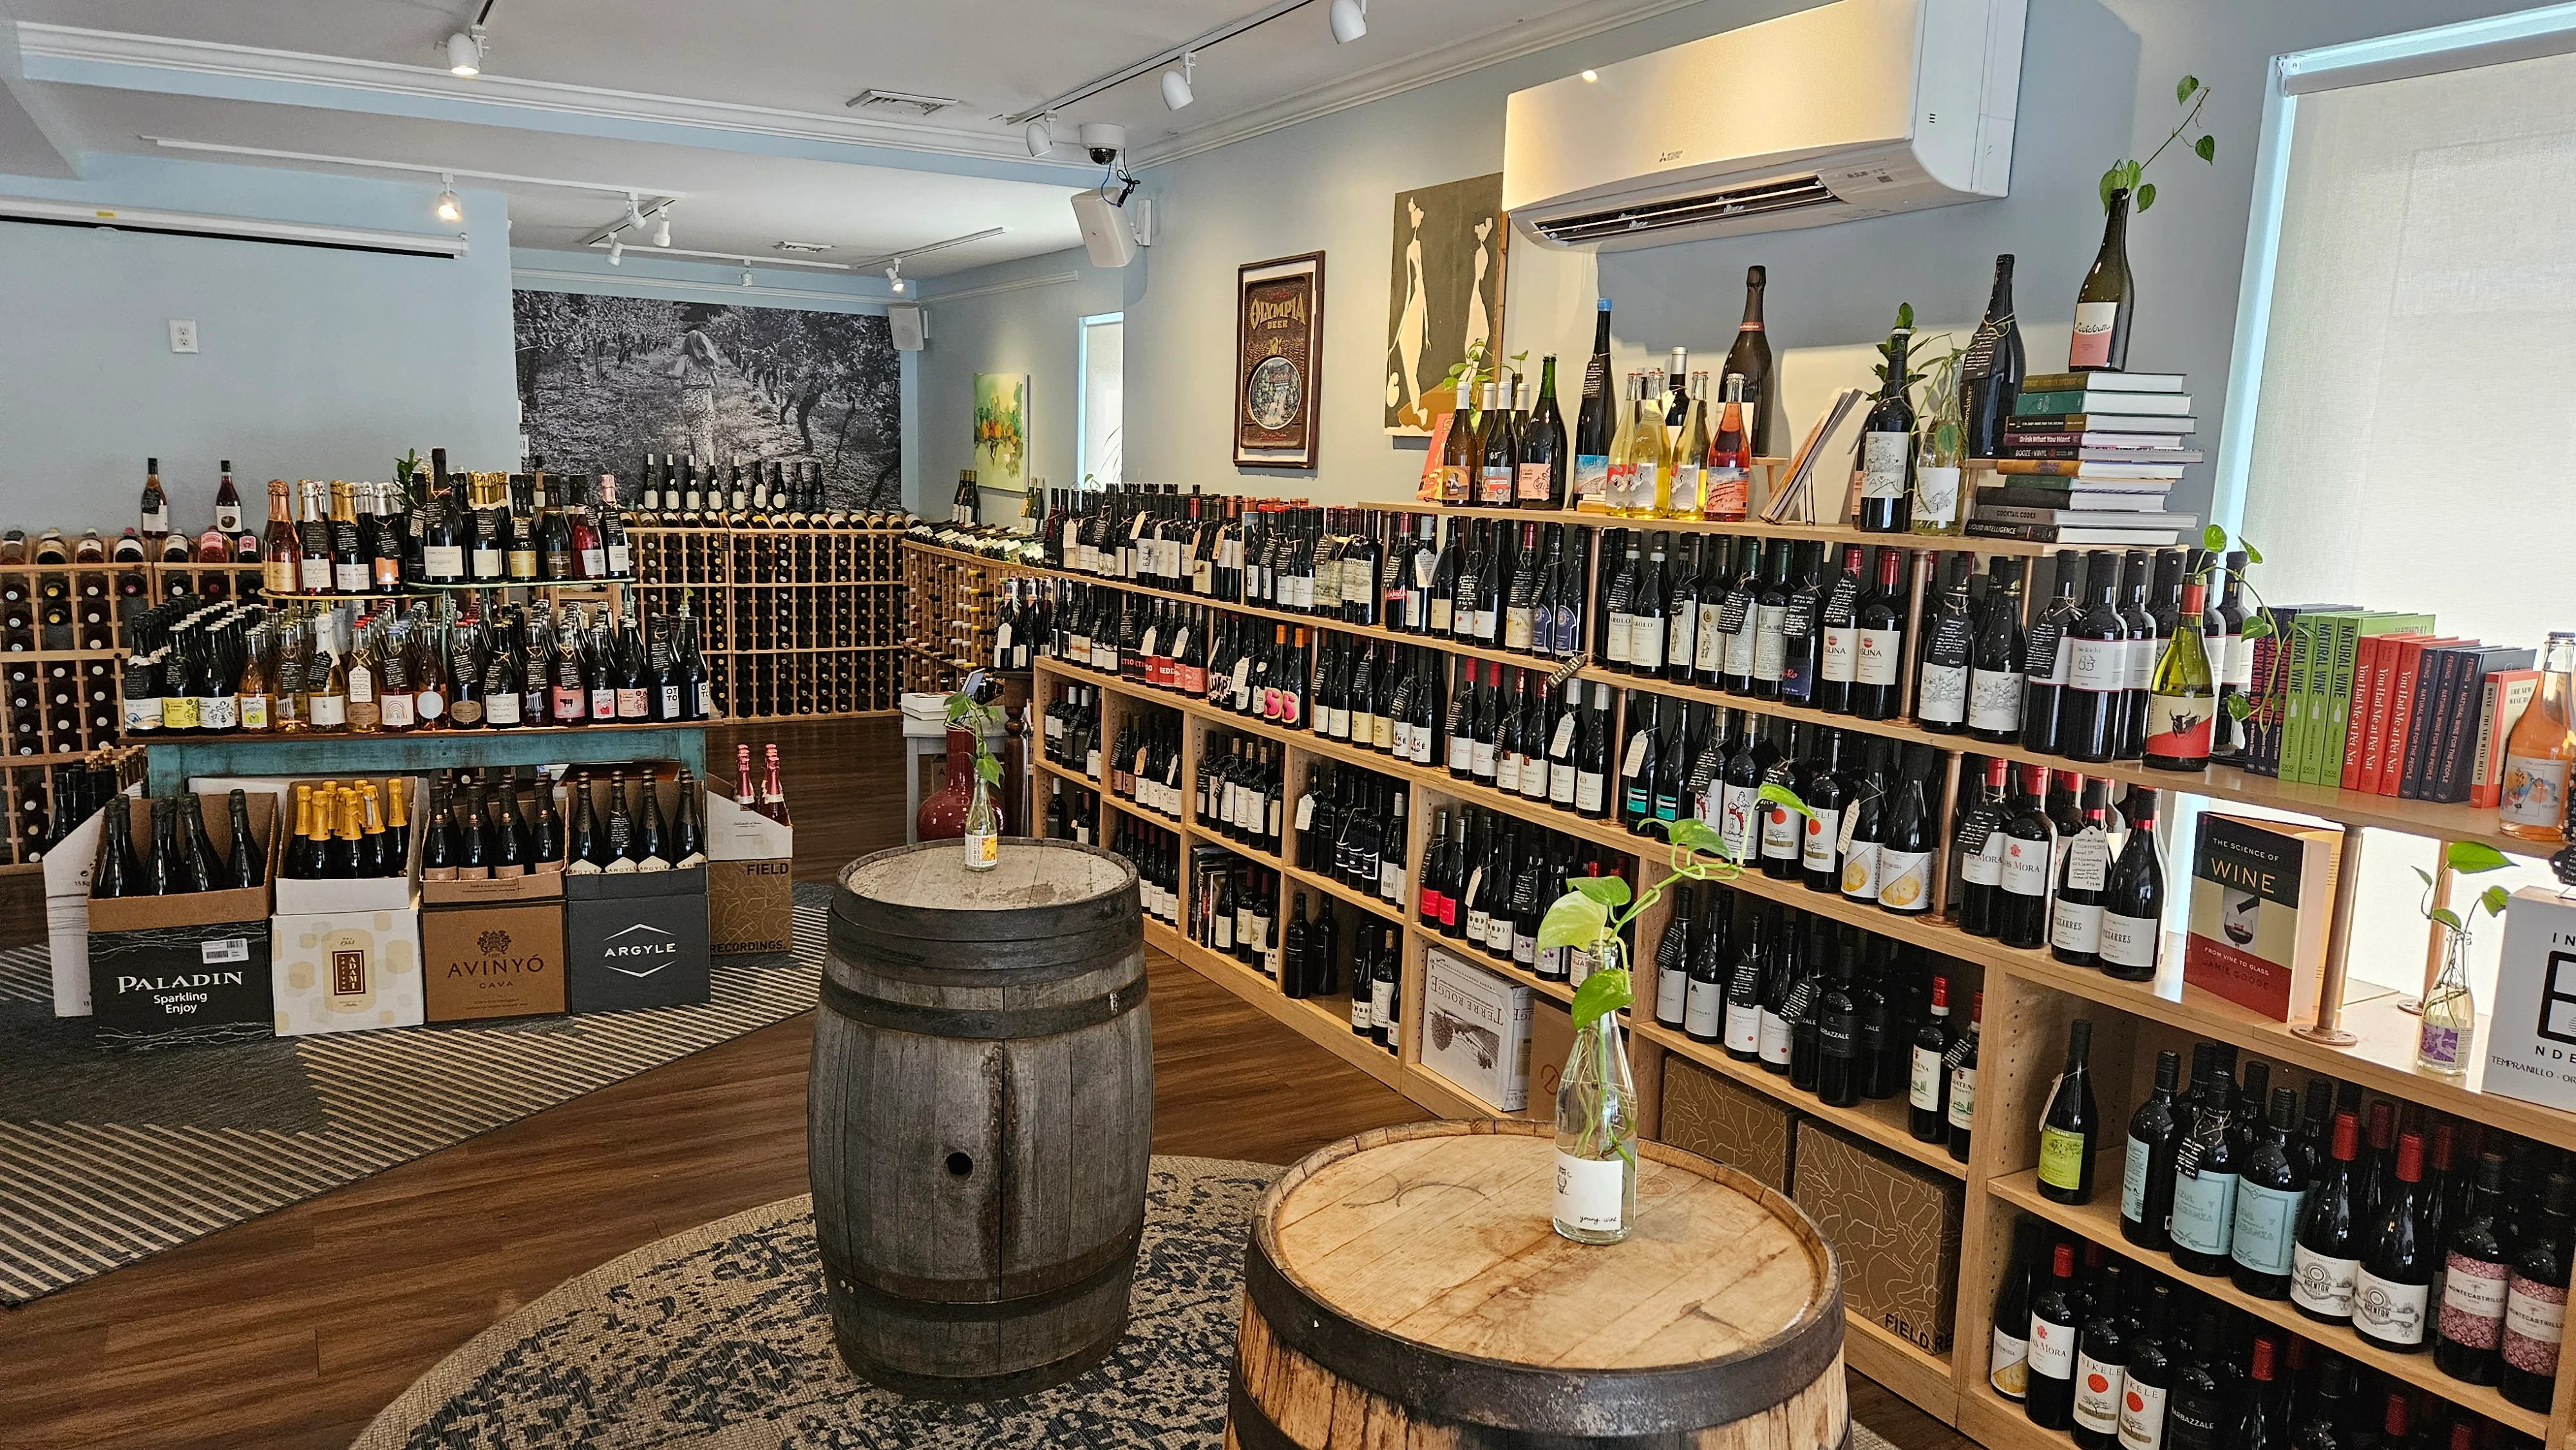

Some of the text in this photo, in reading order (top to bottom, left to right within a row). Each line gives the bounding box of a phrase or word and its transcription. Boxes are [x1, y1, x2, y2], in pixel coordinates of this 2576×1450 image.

[1249, 292, 1305, 330] OLYMPIA
[1267, 319, 1288, 330] BEER
[1968, 523, 2016, 534] LIQUID INTELLIGENCE
[2252, 637, 2265, 692] SPARKLING
[2290, 622, 2309, 695] NATURAL WINE
[2313, 623, 2332, 696] NATURAL WINE
[2334, 625, 2354, 699] NATURAL WINE
[2423, 655, 2432, 679] FEIRING
[2445, 655, 2454, 679] FEIRING
[2360, 664, 2369, 682] You
[2379, 668, 2389, 685] You
[2402, 670, 2412, 689] You
[2464, 657, 2475, 686] FEIRING
[2356, 684, 2366, 703] Had
[2375, 687, 2386, 707] Had
[2398, 690, 2409, 711] Had
[2354, 704, 2363, 718] Me
[2459, 692, 2468, 717] NATURAL
[2351, 720, 2359, 729] at
[2372, 709, 2382, 723] Me
[2396, 713, 2405, 726] Me
[2435, 713, 2443, 733] WINE
[2370, 725, 2378, 735] at
[2393, 728, 2400, 739] at
[2454, 717, 2463, 736] WINE
[2448, 748, 2456, 760] THE
[2405, 755, 2415, 780] PEOPLE
[2426, 756, 2436, 781] PEOPLE
[2441, 759, 2452, 784] PEOPLE
[2213, 838, 2279, 862] THE SCIENCE OF
[746, 862, 790, 876] FIELD
[2014, 862, 2040, 872] MORA
[2211, 857, 2276, 894] WINE
[604, 943, 676, 957] ARGYLE
[446, 954, 544, 978] AVINYÓ
[2204, 946, 2222, 957] FROM
[2223, 954, 2238, 964] VINE
[2249, 965, 2269, 976] GLASS
[115, 971, 243, 994] PALADIN
[348, 956, 358, 990] ADAMI
[478, 981, 513, 989] CAVA
[153, 992, 207, 1005] Sparkling
[1430, 975, 1504, 1026] TERRE ROUGE
[166, 1003, 198, 1015] Enjoy
[2491, 1055, 2553, 1078] TEMPRANILLO
[1580, 1215, 1598, 1225] young
[2304, 1277, 2330, 1293] AGENTOR
[2448, 1283, 2505, 1304] MONTECASTRILLO
[2364, 1301, 2390, 1318] AGENTOR
[1885, 1312, 1929, 1349] FIELD
[2040, 1341, 2067, 1358] MORA
